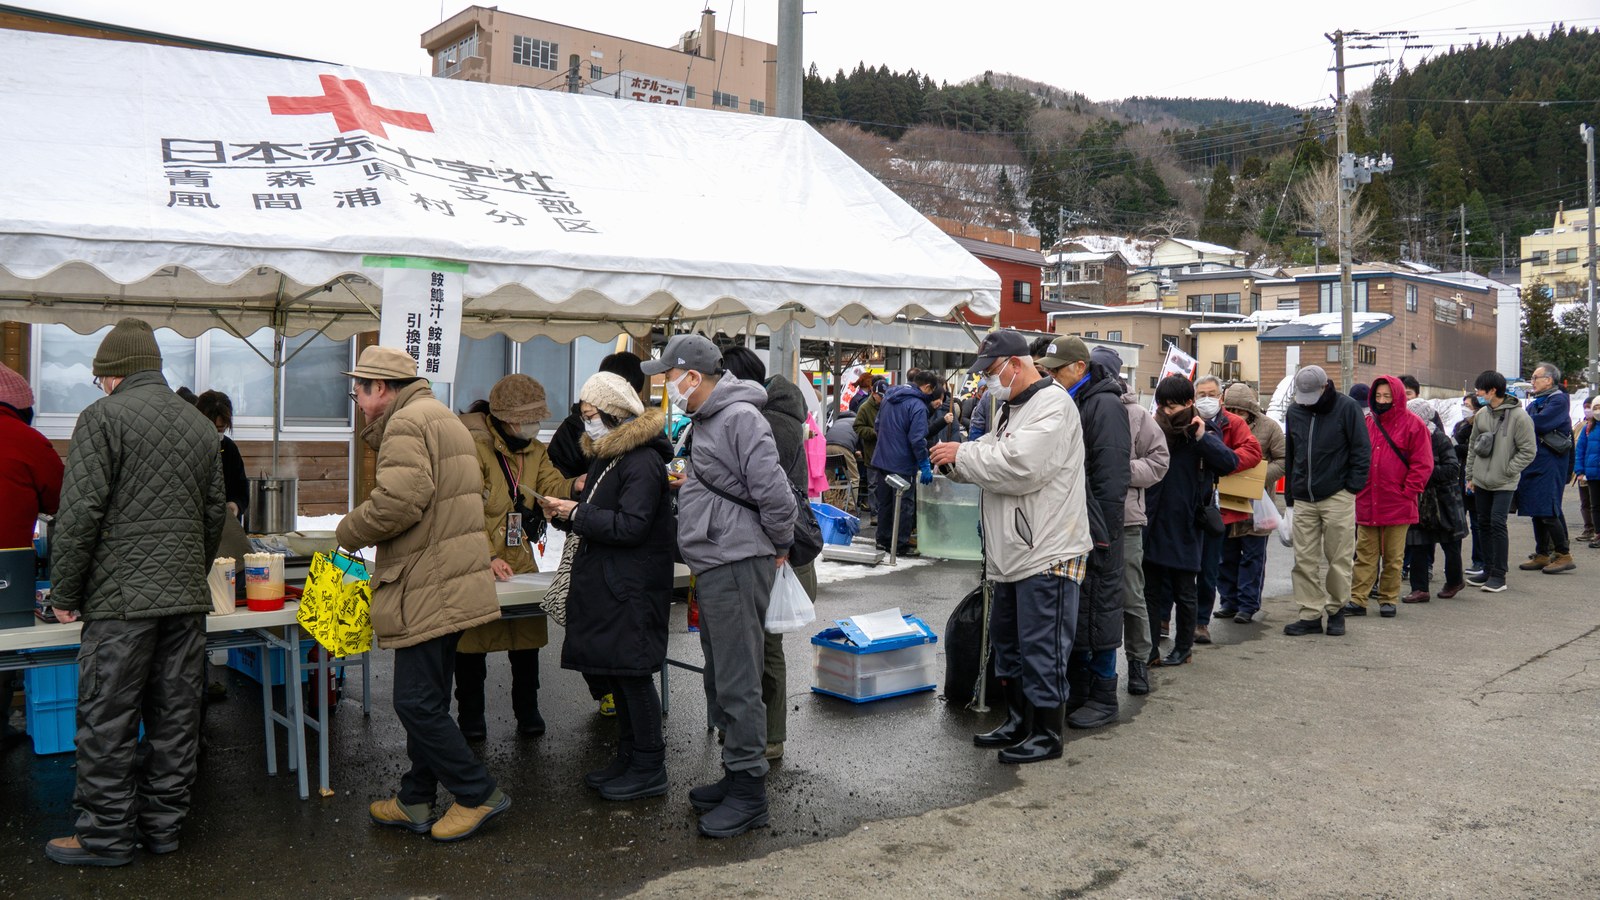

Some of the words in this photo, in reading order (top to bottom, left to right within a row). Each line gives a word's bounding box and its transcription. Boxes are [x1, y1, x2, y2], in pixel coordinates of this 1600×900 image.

[631, 77, 679, 94] ホテルニュー
[161, 136, 566, 194] 日本赤十字社
[164, 162, 582, 215] 青森県支部
[166, 187, 602, 233] 風間浦村分区
[406, 313, 421, 369] 引換場
